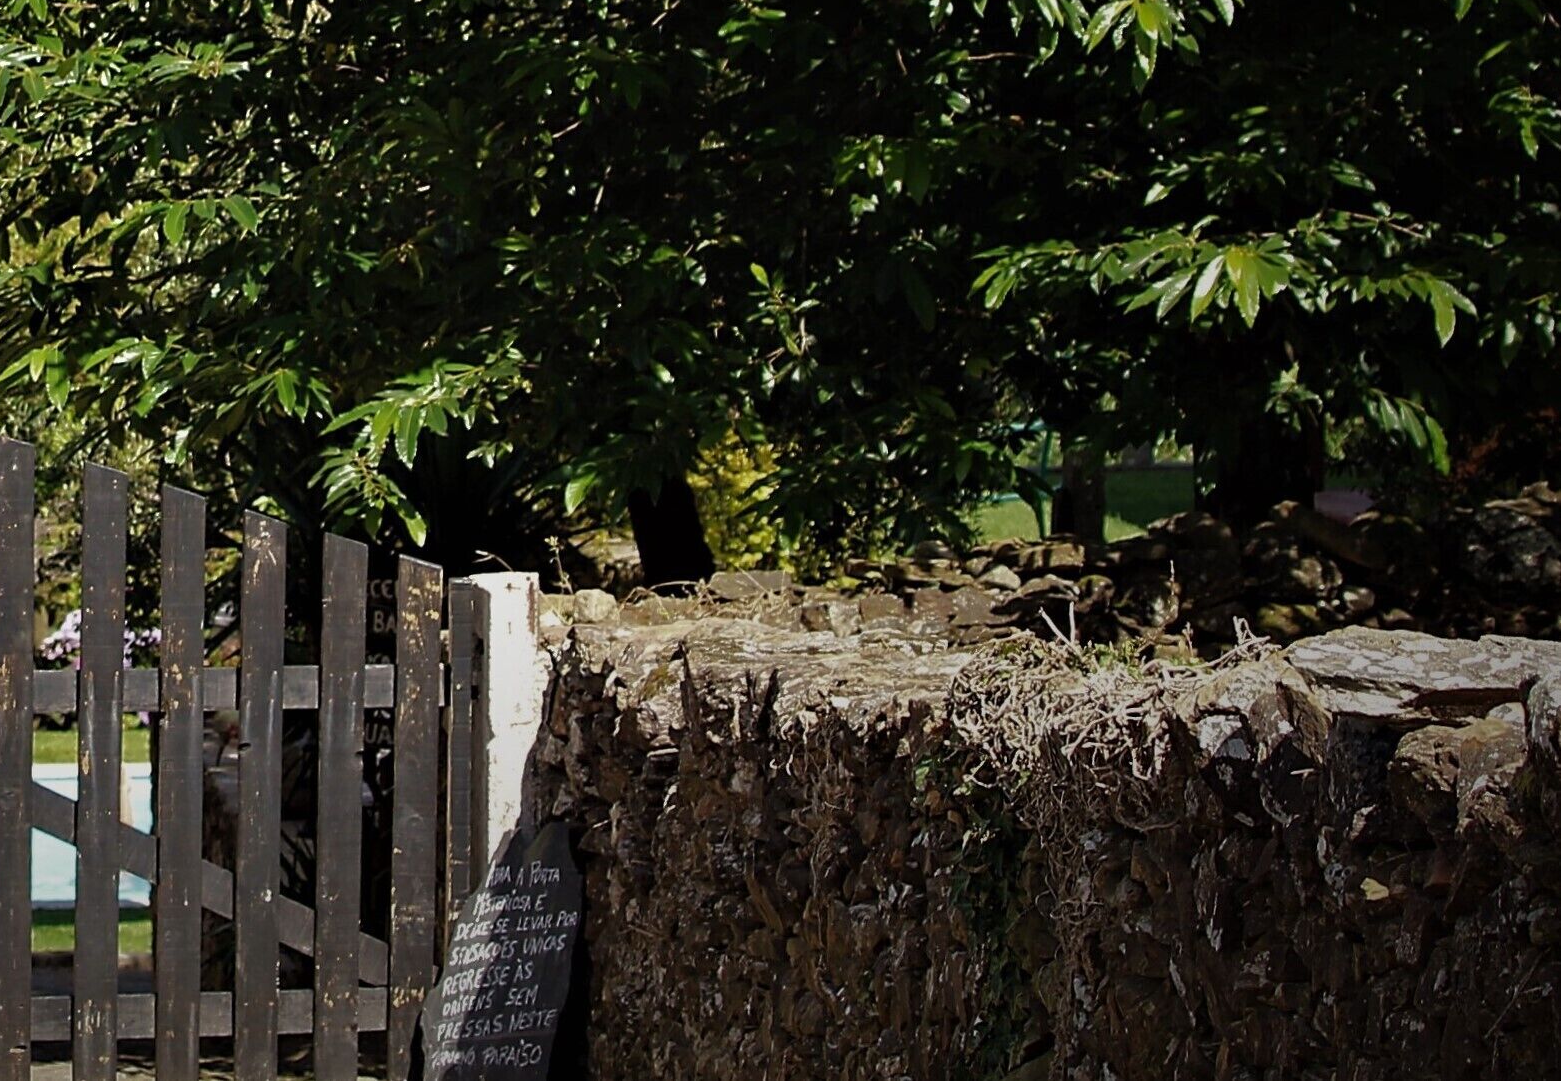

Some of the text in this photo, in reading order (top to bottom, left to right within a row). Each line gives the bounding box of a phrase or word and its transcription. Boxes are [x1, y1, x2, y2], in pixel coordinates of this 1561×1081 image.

[516, 914, 552, 932] LEVAR
[556, 910, 578, 927] POR
[442, 966, 510, 998] REGRESSE
[505, 984, 539, 1006] SEM
[438, 1009, 558, 1041] PRESSAS NESTE
